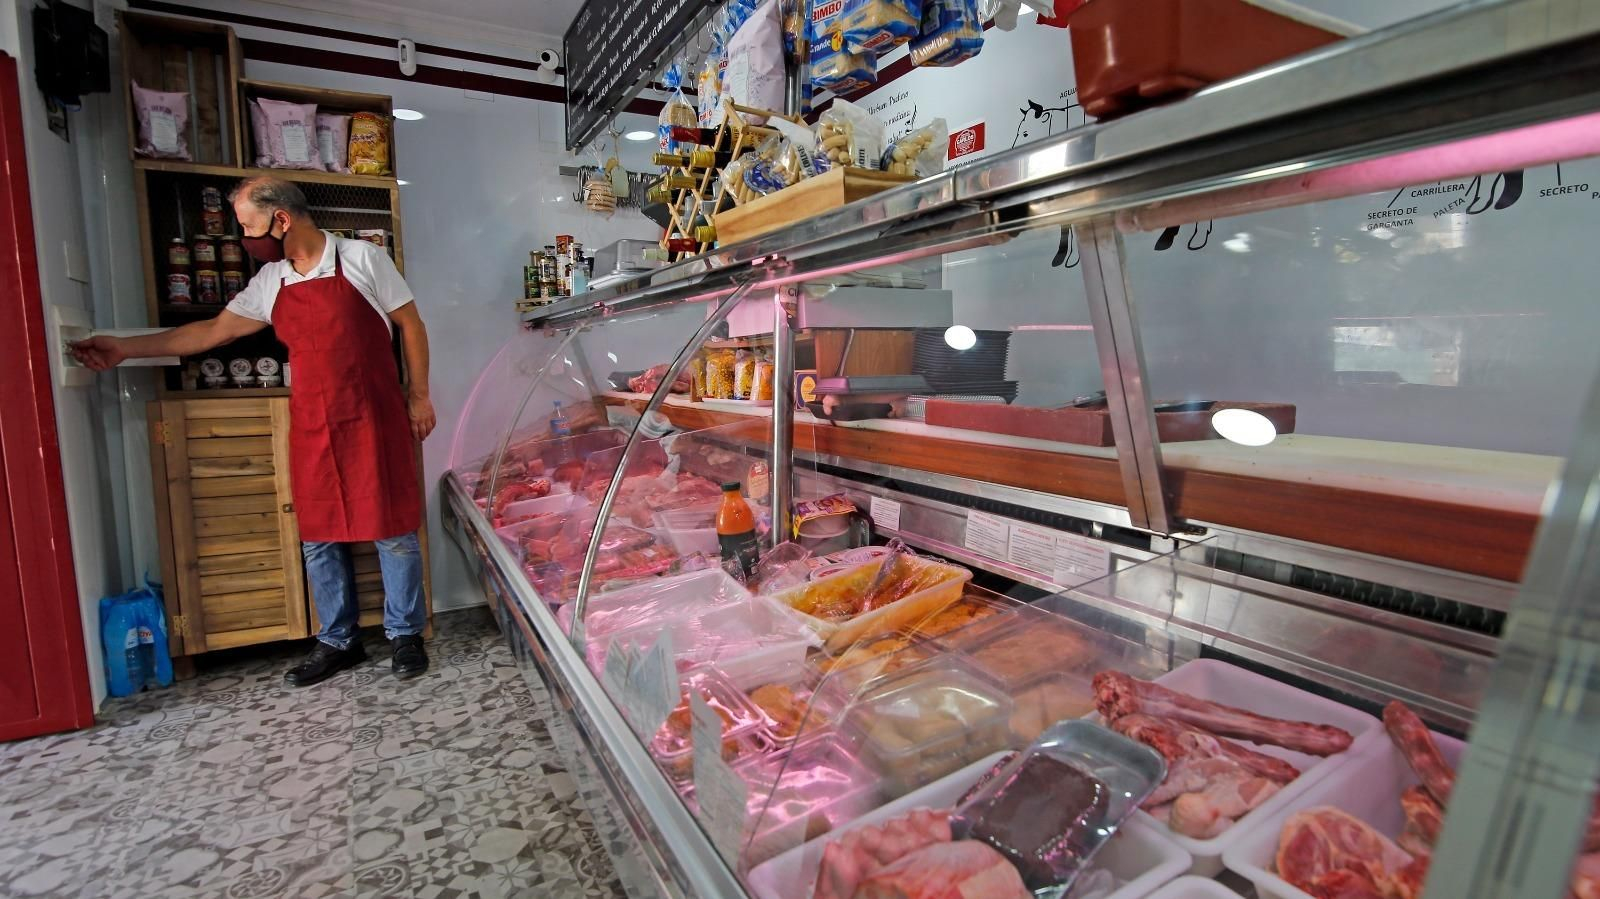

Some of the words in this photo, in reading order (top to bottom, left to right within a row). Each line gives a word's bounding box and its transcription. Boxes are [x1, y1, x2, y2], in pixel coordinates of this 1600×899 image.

[811, 1, 842, 21] BIMBO
[1411, 183, 1465, 198] CARRILLERA
[1540, 183, 1589, 197] SECRETO
[1367, 208, 1404, 220] SECRETO
[1406, 206, 1418, 215] DE
[1433, 197, 1466, 219] PALETA
[1366, 219, 1414, 231] GARGANTA
